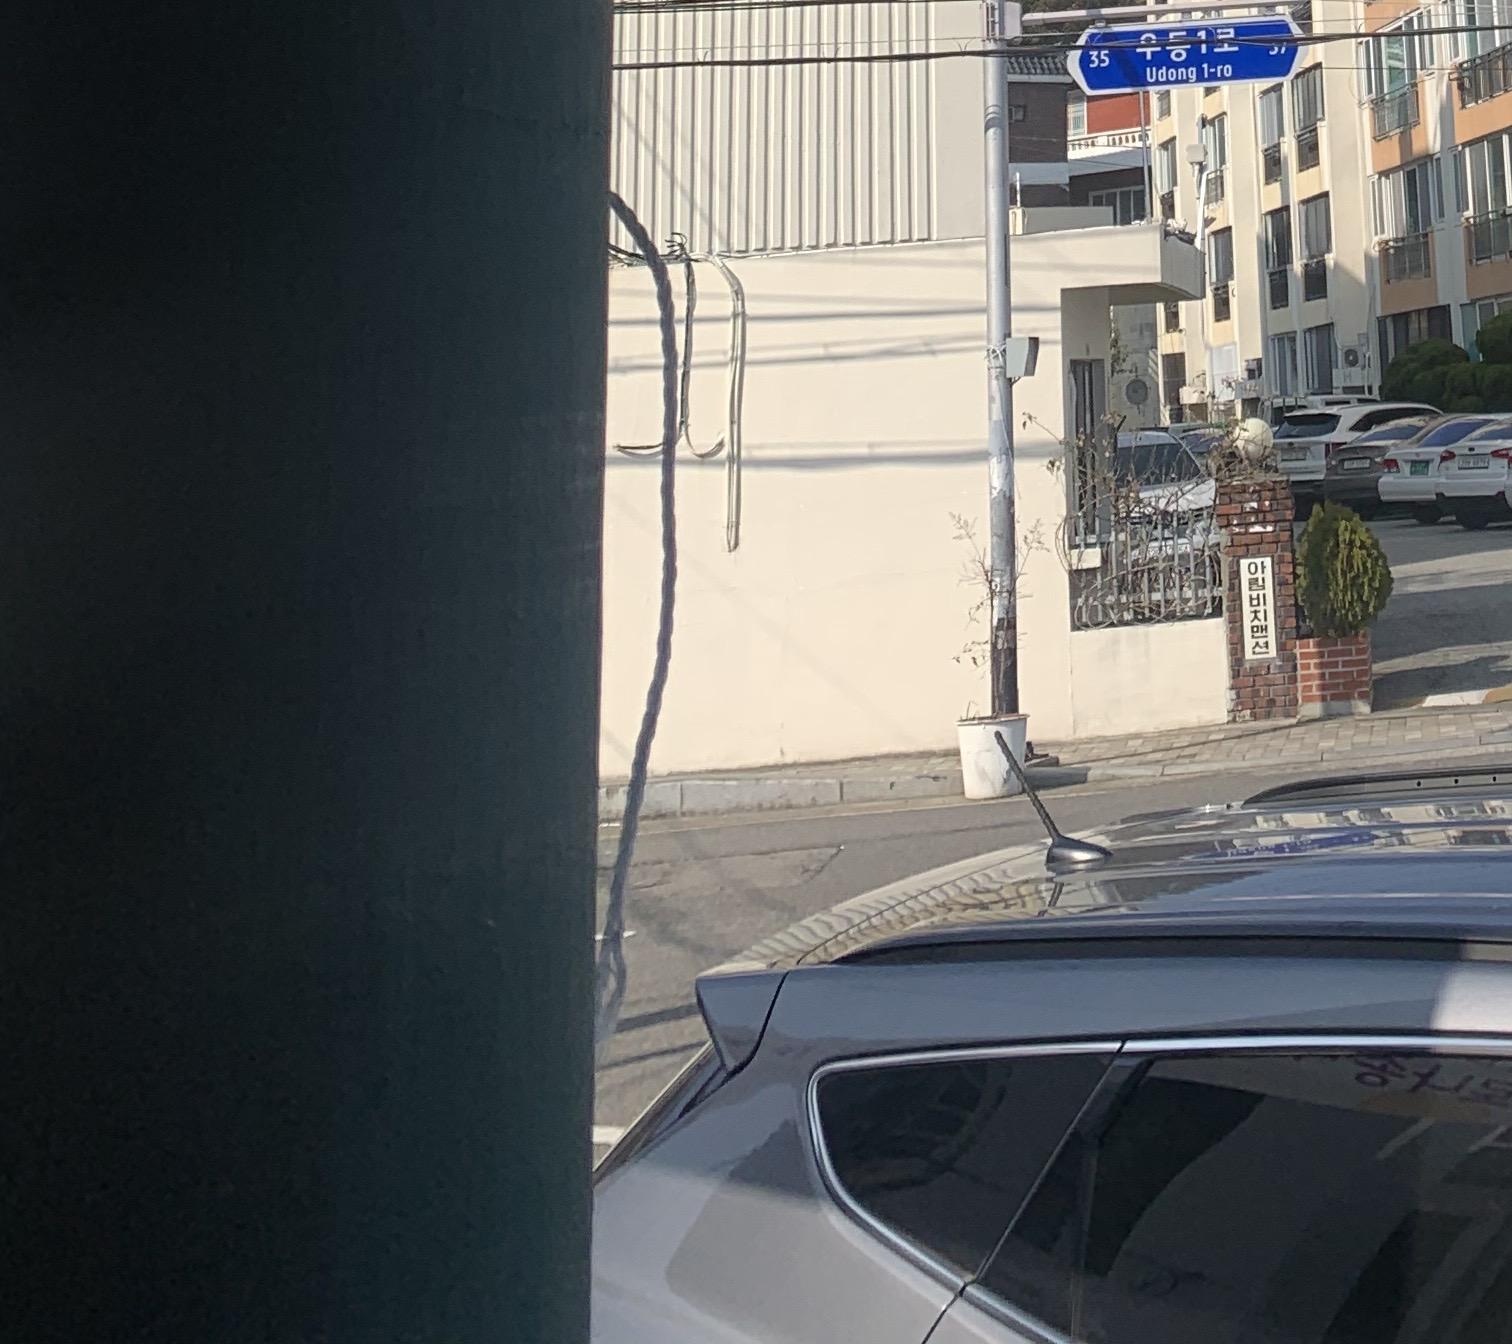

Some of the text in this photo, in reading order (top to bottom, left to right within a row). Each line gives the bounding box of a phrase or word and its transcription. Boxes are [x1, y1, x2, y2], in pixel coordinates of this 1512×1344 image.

[1135, 27, 1240, 62] 우동1로
[1089, 50, 1110, 68] 35
[1146, 63, 1233, 83] Udong 1-ro
